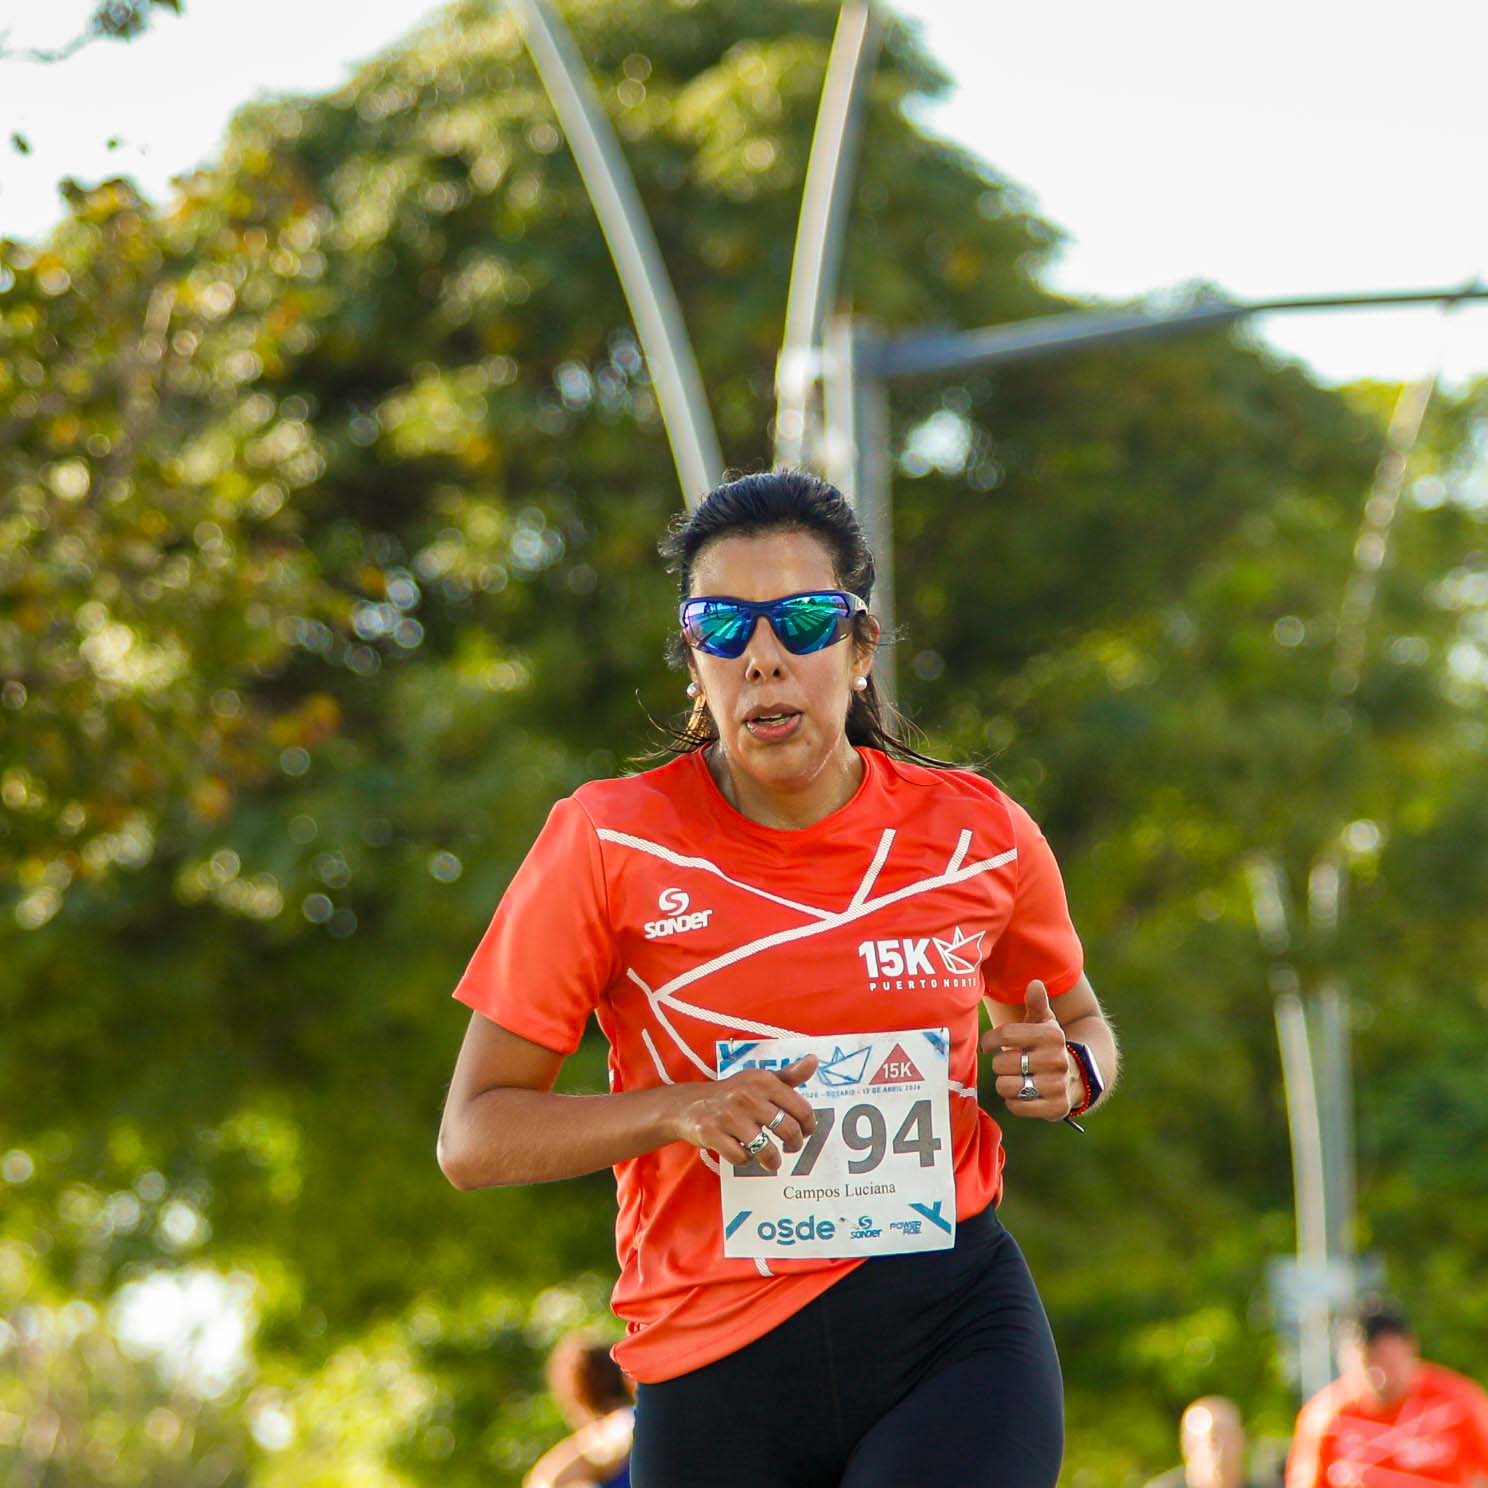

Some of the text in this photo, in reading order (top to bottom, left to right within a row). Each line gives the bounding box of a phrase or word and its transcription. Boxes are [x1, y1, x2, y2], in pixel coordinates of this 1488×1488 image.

[858, 938, 936, 978] 15K
[869, 979, 938, 991] PUERTO
[883, 1060, 912, 1079] 15K
[733, 1100, 942, 1177] 794
[783, 1182, 897, 1202] Campos Luciana
[757, 1215, 836, 1245] osde
